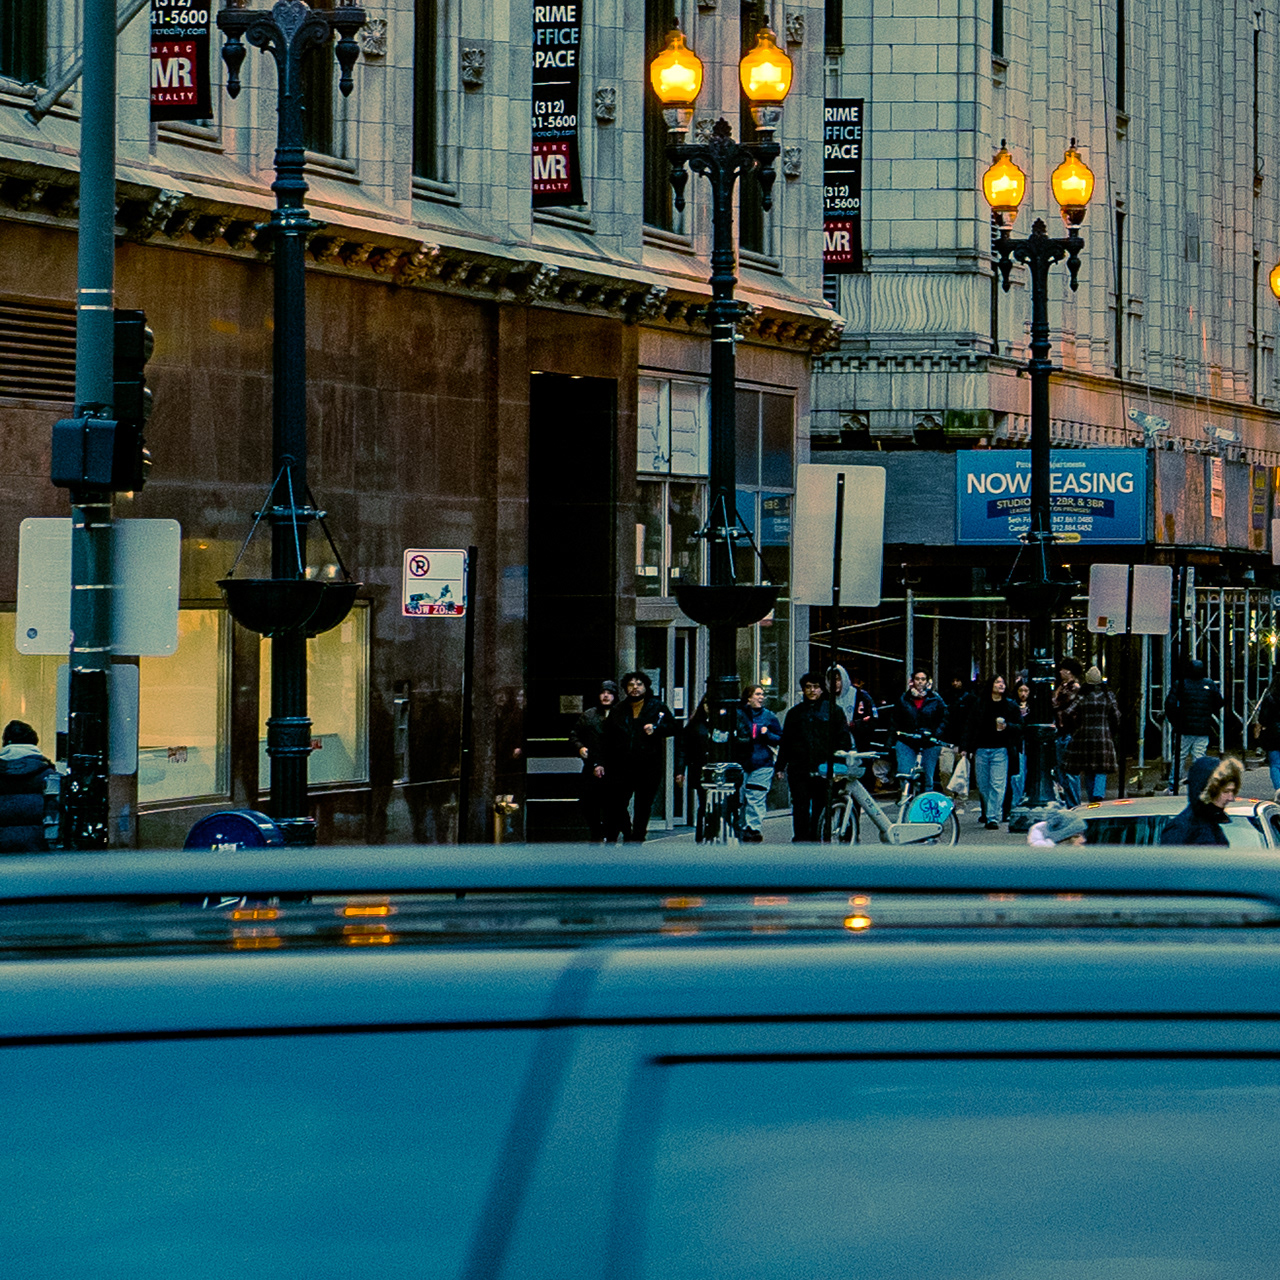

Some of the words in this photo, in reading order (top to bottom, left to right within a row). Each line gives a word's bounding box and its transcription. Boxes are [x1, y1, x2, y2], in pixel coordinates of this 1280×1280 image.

[150, 10, 208, 24] 41-5600
[533, 5, 576, 23] RIME
[533, 27, 579, 46] FFICE
[533, 50, 576, 69] PACE
[152, 57, 194, 89] MR
[535, 99, 565, 115] (312)
[825, 106, 859, 122] RIME
[532, 115, 576, 129] 41-5600
[825, 125, 862, 141] FFICE
[824, 143, 859, 159] PACE
[533, 154, 568, 180] MR
[534, 183, 569, 191] REALTY
[824, 185, 849, 197] (312)
[823, 198, 860, 209] 1-5600
[823, 231, 851, 252] MR
[967, 473, 1032, 494] NOW
[1050, 472, 1134, 494] EASING
